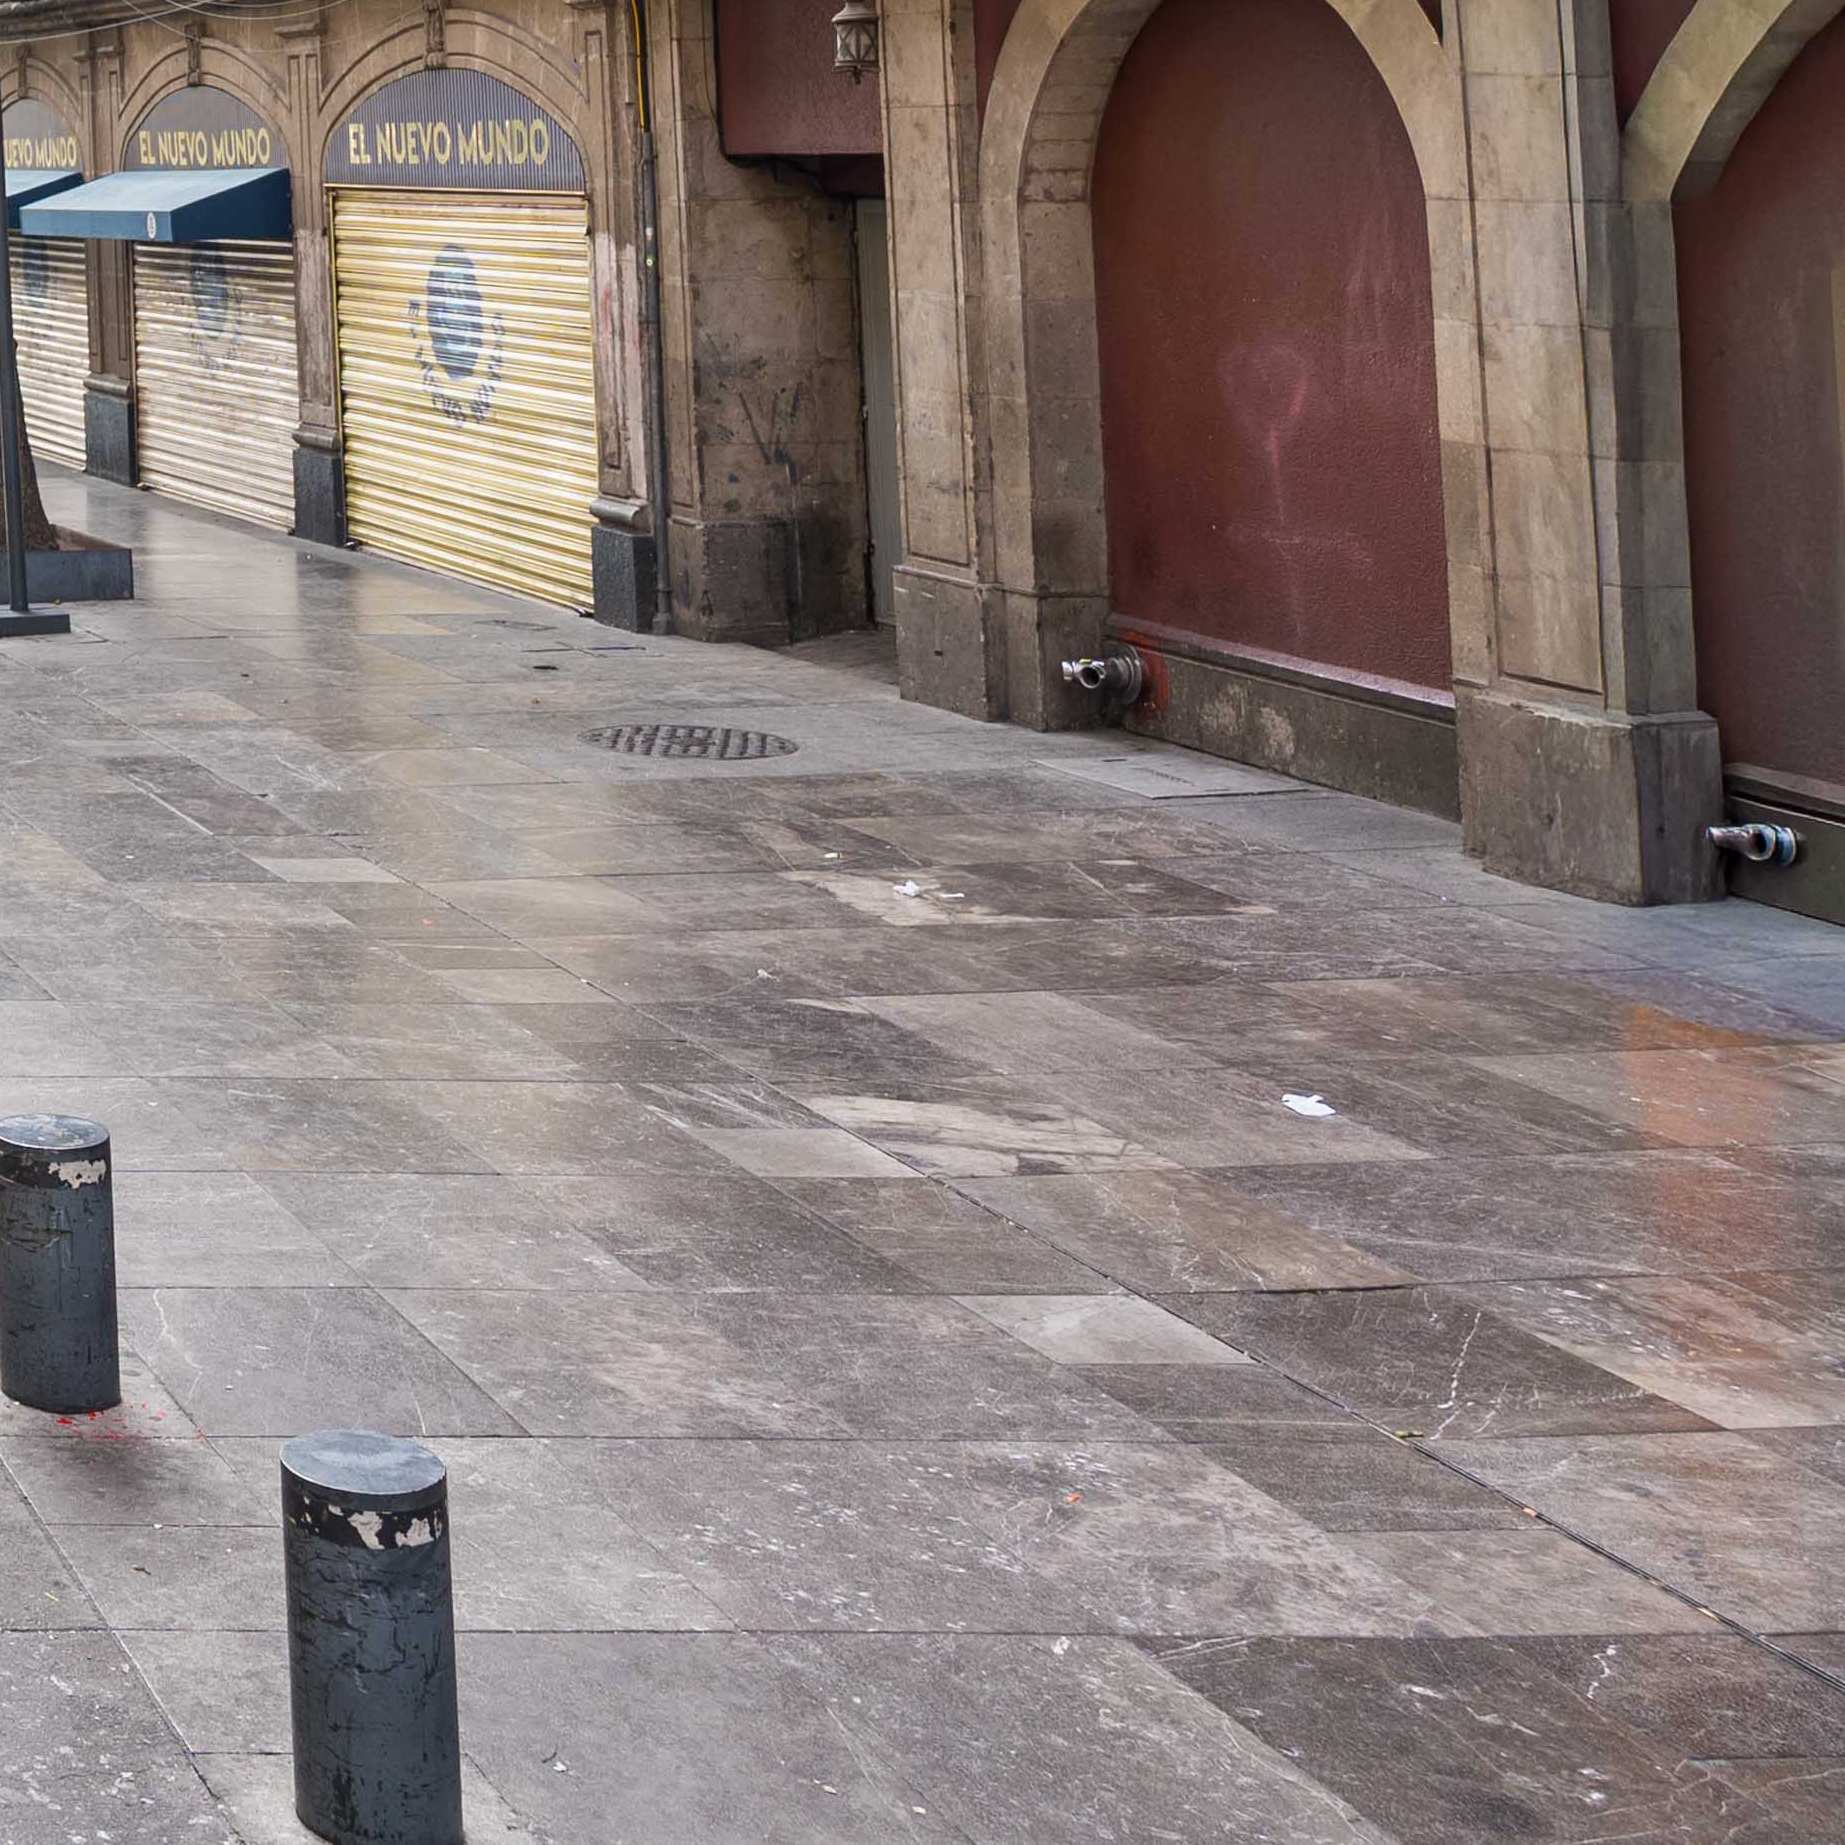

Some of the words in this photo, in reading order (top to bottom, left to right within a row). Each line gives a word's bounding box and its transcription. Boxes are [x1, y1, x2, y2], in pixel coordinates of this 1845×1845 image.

[4, 137, 34, 167] UEVO
[35, 135, 77, 168] MUNDO
[139, 131, 157, 165] EL
[159, 130, 208, 166] NUEVO
[212, 127, 270, 166] MUNDO
[348, 122, 372, 165] EL
[376, 121, 452, 166] NUEVO
[458, 118, 550, 166] MUNDO
